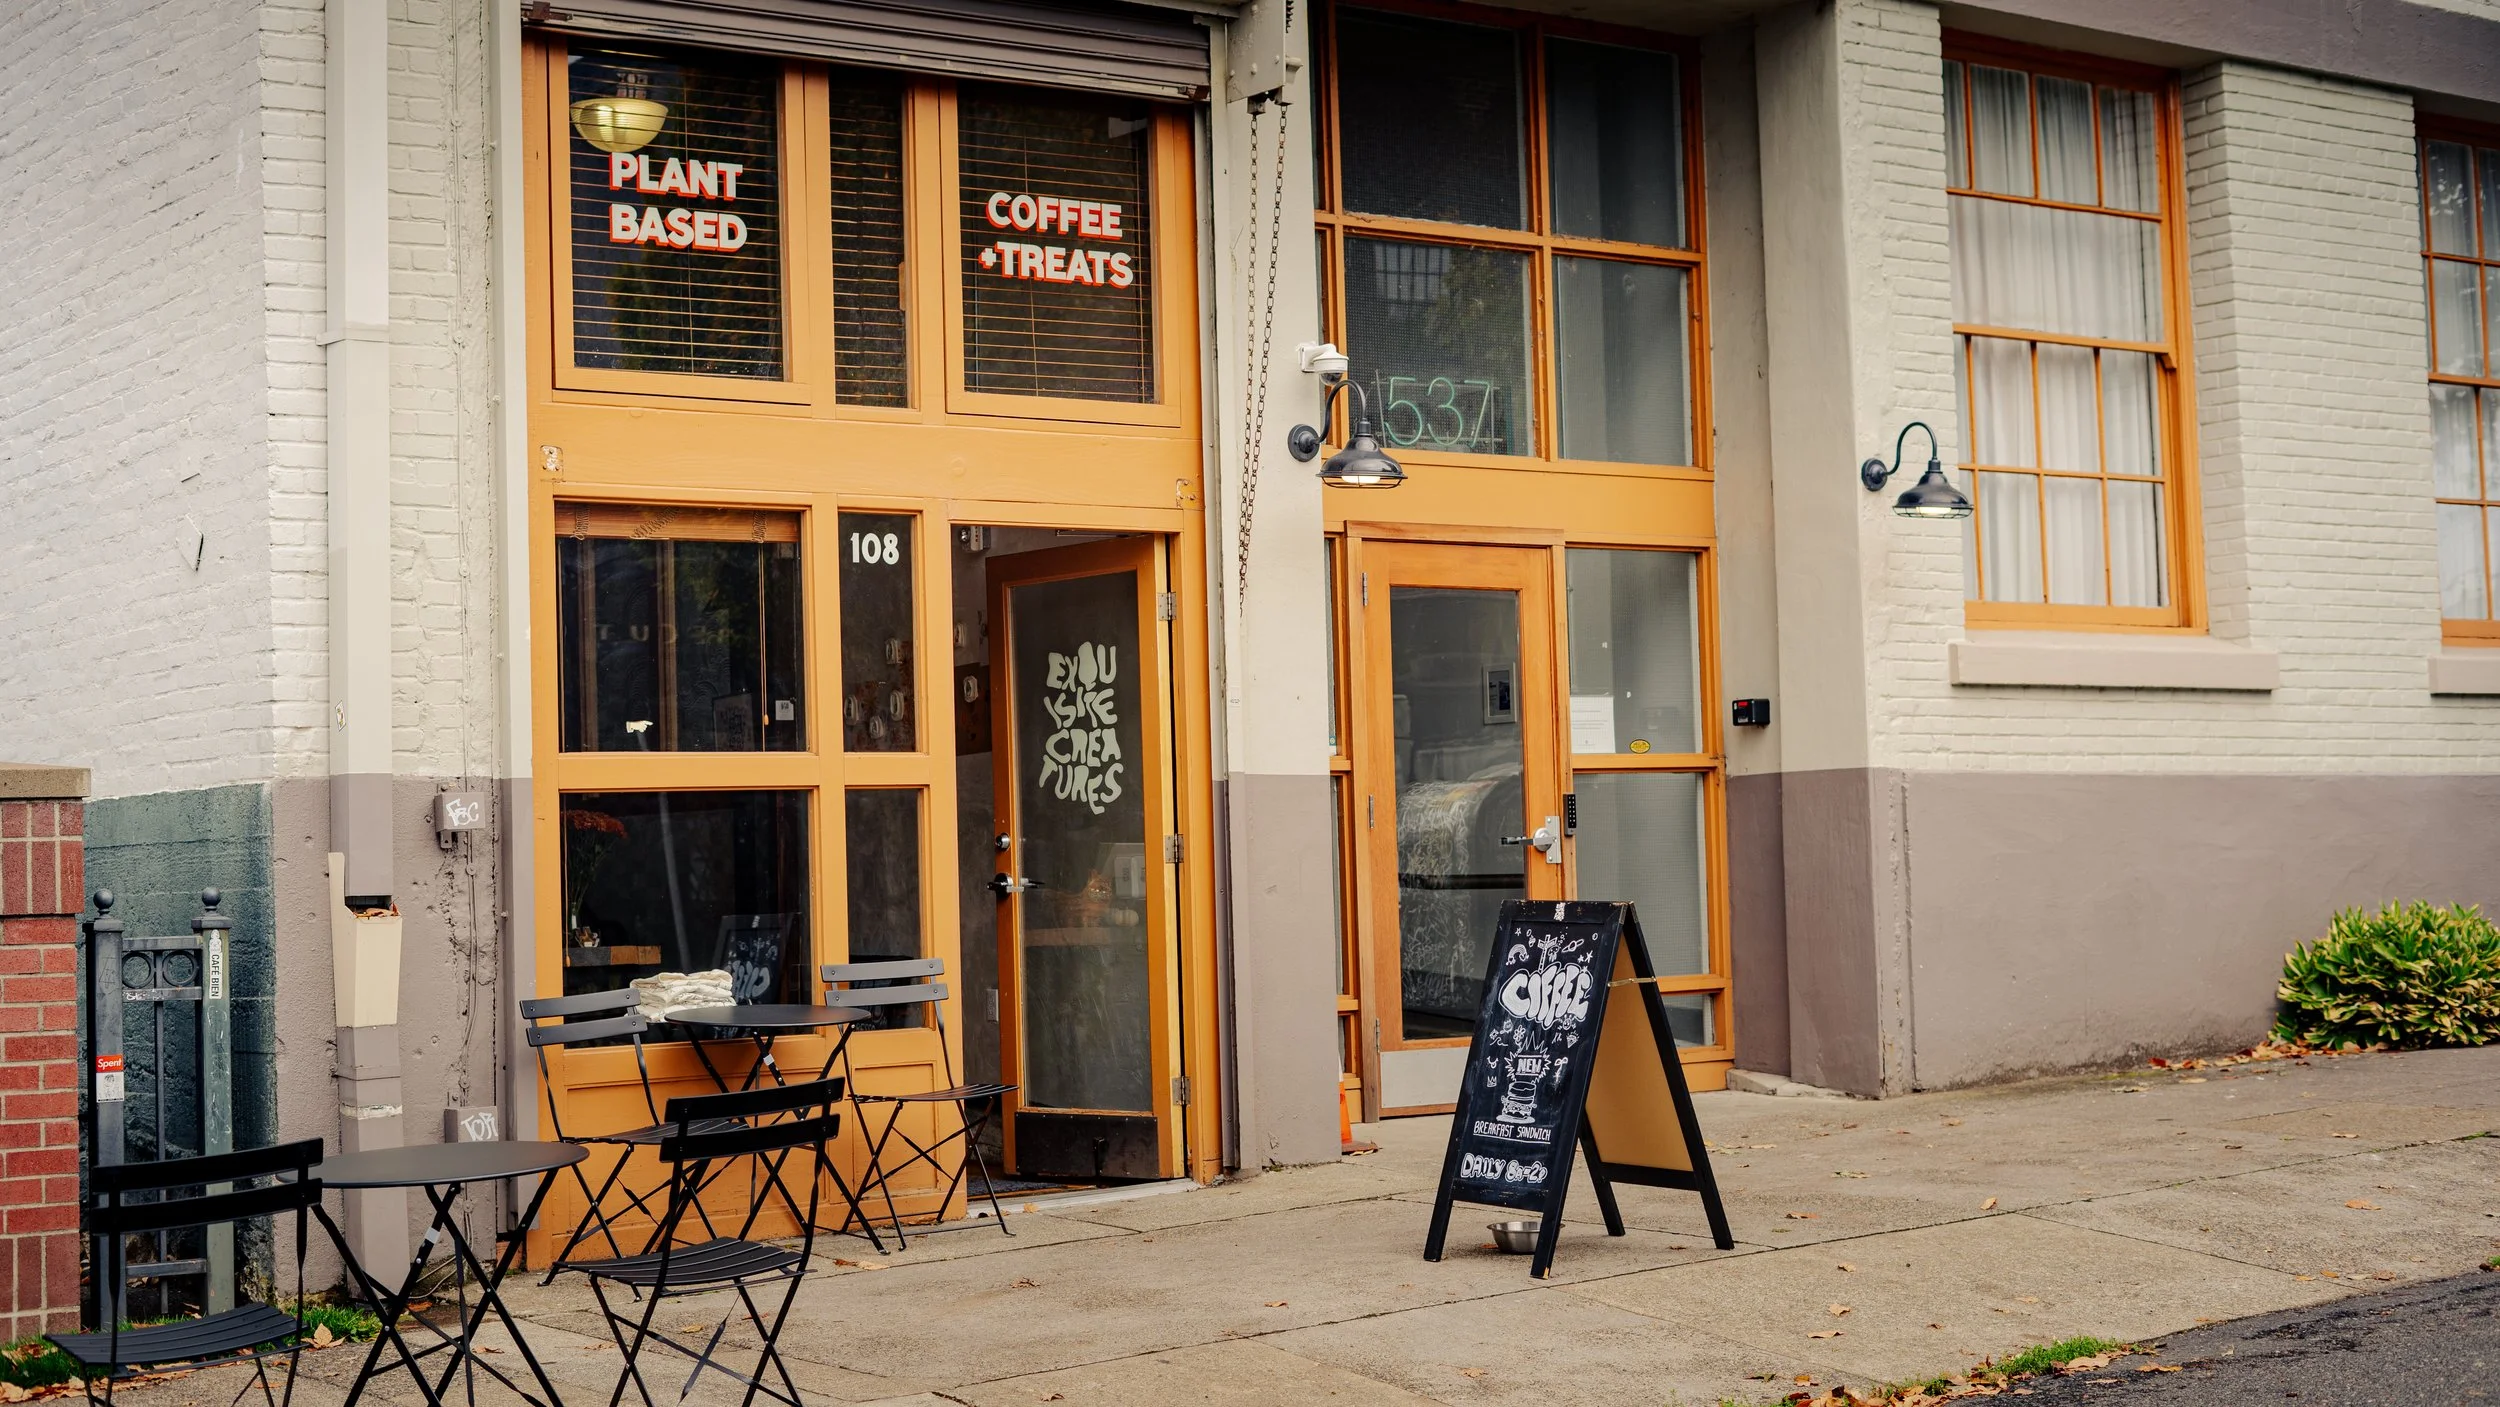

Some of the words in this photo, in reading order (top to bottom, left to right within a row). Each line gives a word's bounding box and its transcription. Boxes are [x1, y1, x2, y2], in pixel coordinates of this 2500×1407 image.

[609, 152, 743, 201] PLANT
[609, 203, 748, 252] BASED
[985, 192, 1123, 240] COFFEE
[1384, 376, 1490, 448] 537
[850, 532, 900, 565] 108
[211, 954, 220, 977] CAFÉ
[211, 978, 220, 998] BIEN
[1499, 962, 1593, 1030] COFFEE
[97, 1058, 122, 1070] Spent
[1517, 1058, 1542, 1073] NEW
[1473, 1120, 1514, 1138] BREAKFAST
[1517, 1125, 1551, 1142] SANDWICH
[1460, 1153, 1506, 1179] DAILY
